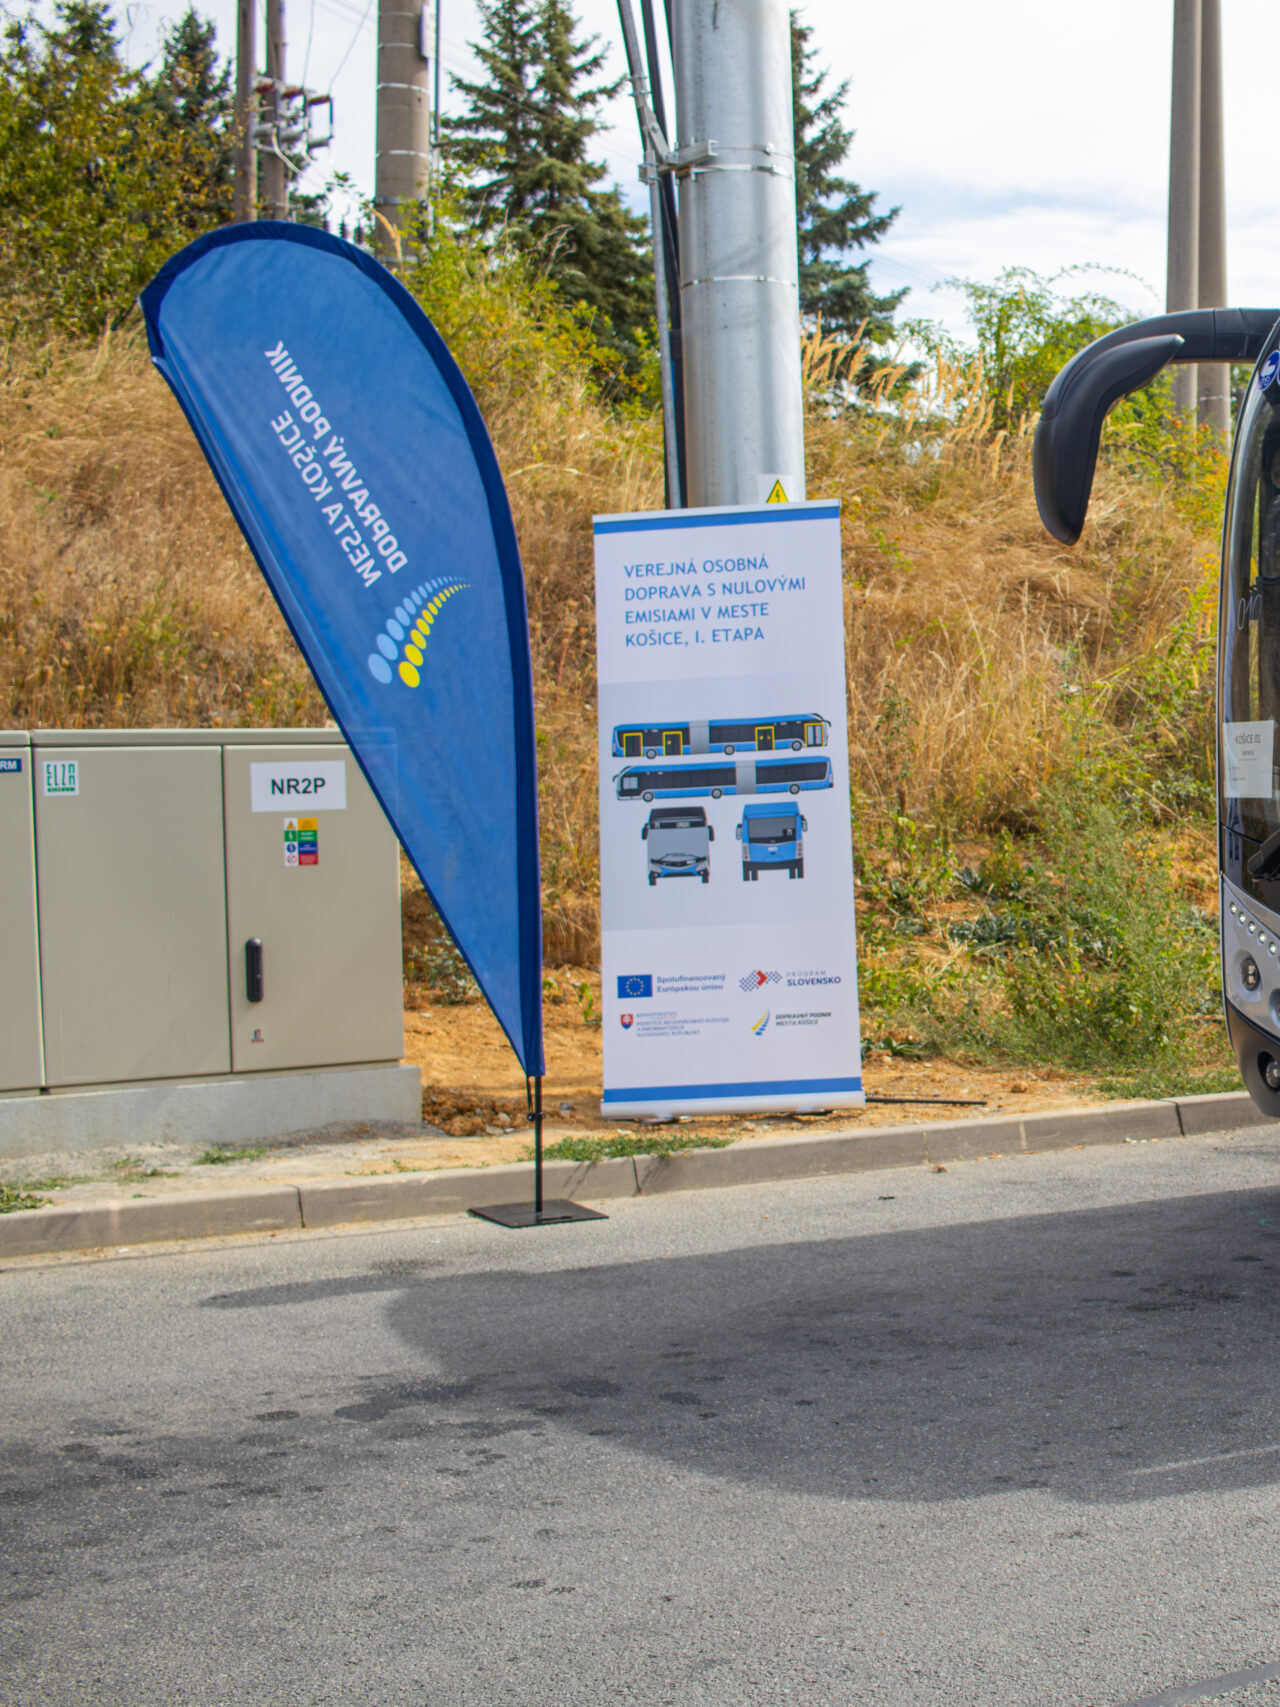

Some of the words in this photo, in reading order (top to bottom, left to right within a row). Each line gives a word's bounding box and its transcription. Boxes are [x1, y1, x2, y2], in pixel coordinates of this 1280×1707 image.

[623, 557, 698, 578] VEREJNÁ
[703, 552, 769, 574] OSOBNÁ
[624, 583, 701, 601] DOPRAVA
[707, 582, 716, 597] S
[722, 574, 806, 595] NULOVÝMI
[624, 607, 696, 625] EMISIAMI
[700, 606, 712, 620] V
[717, 602, 770, 619] MESTE
[625, 628, 690, 648] KOŠICE,
[695, 629, 705, 644] I.
[712, 626, 765, 643] ETAPA
[271, 777, 326, 795] NR2P
[787, 976, 842, 987] SLOVENSKO
